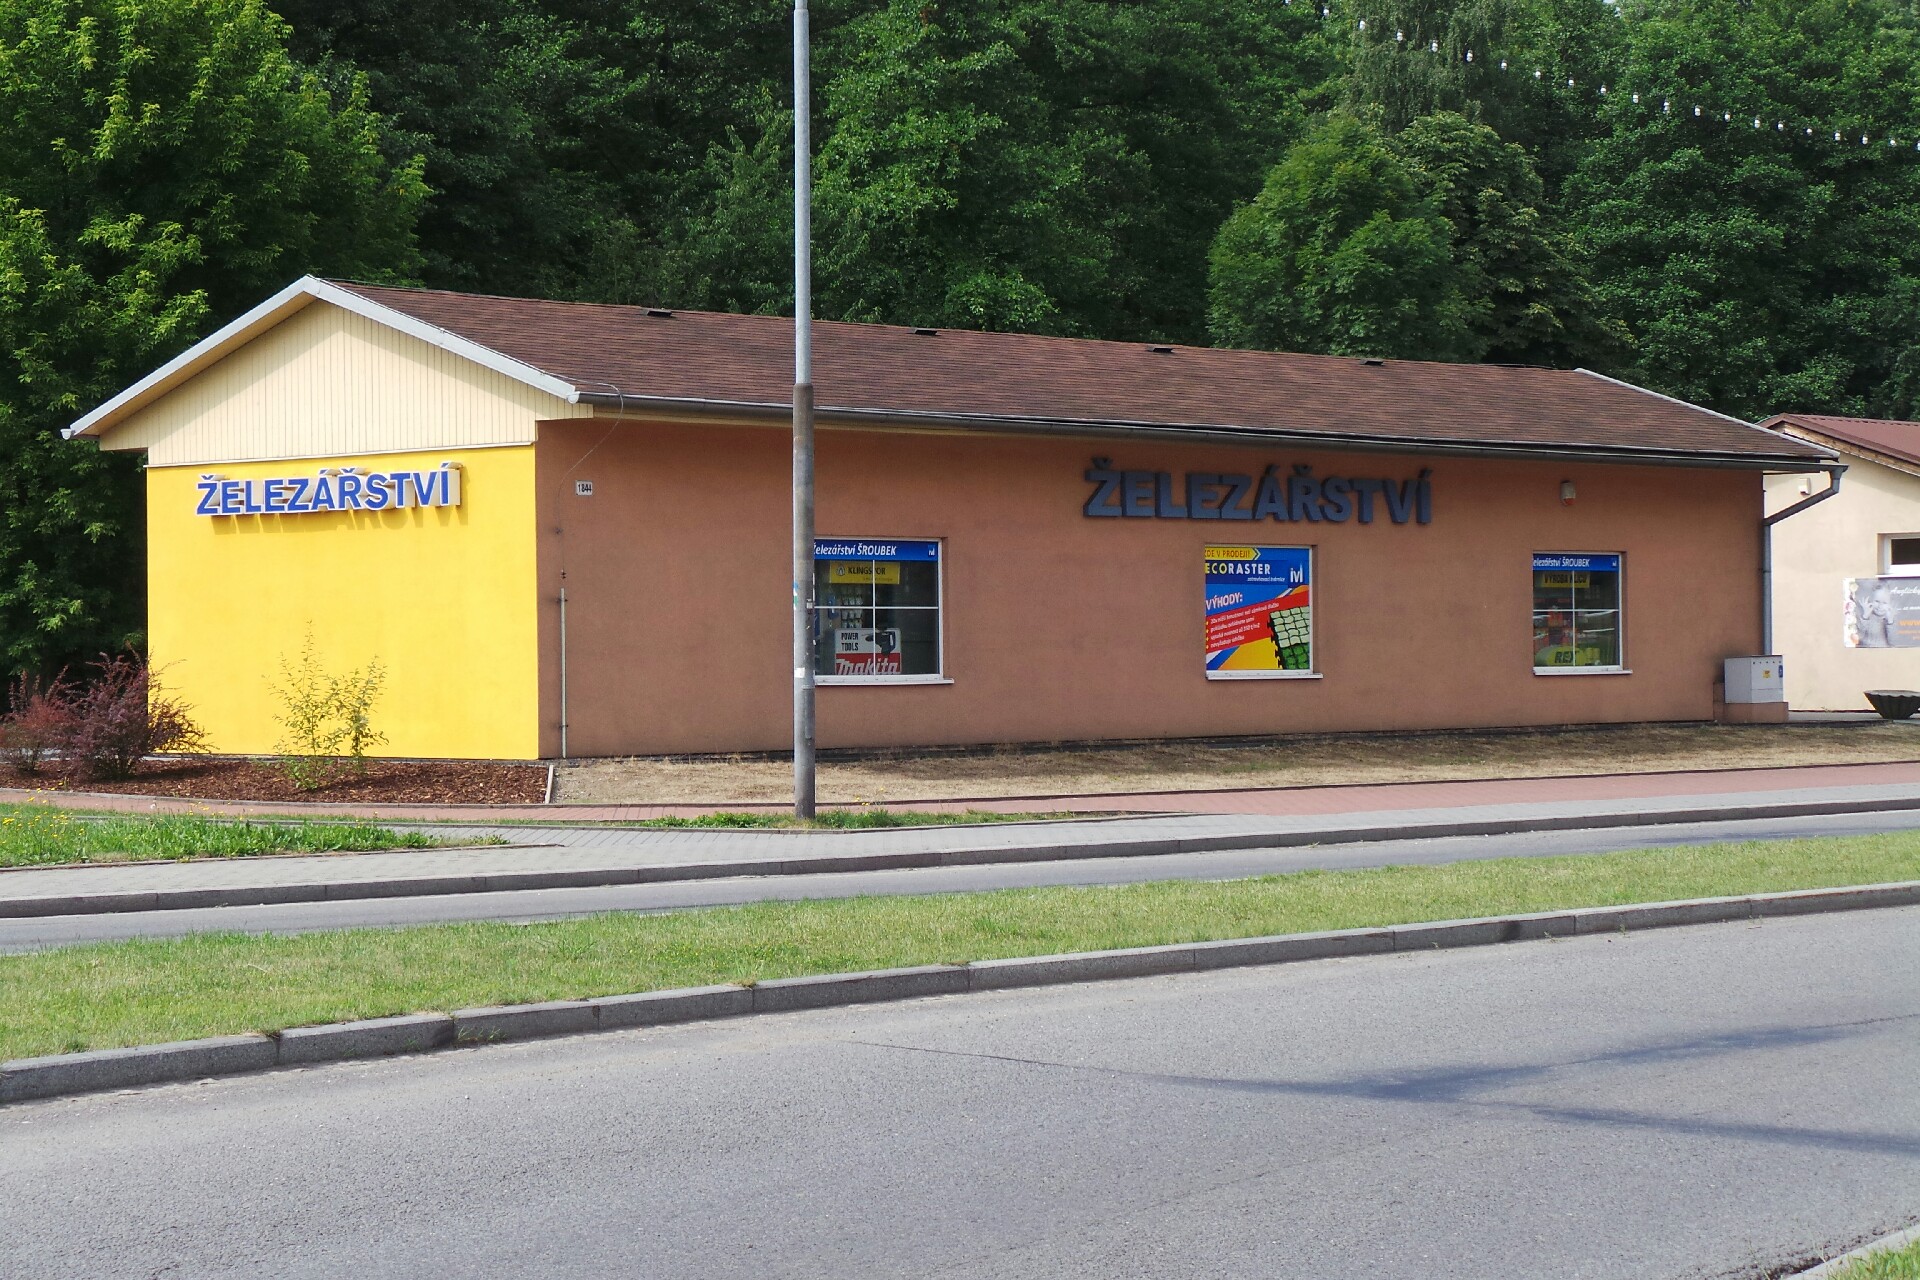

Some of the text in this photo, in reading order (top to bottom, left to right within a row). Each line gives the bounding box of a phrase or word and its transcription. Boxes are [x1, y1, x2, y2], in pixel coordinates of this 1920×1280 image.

[196, 462, 451, 515] ŽELEZÁŘSTVÍ
[578, 483, 592, 493] 1844
[1083, 457, 1432, 524] ŽELEZÁŘSTVÍ
[857, 543, 897, 556] ŠROUBEK
[1562, 557, 1590, 567] ŠROUBEK
[1205, 563, 1271, 575] ECORASTER
[1206, 591, 1243, 610] VÝHODY:
[841, 643, 858, 651] TOOLS
[836, 657, 900, 675] makita
